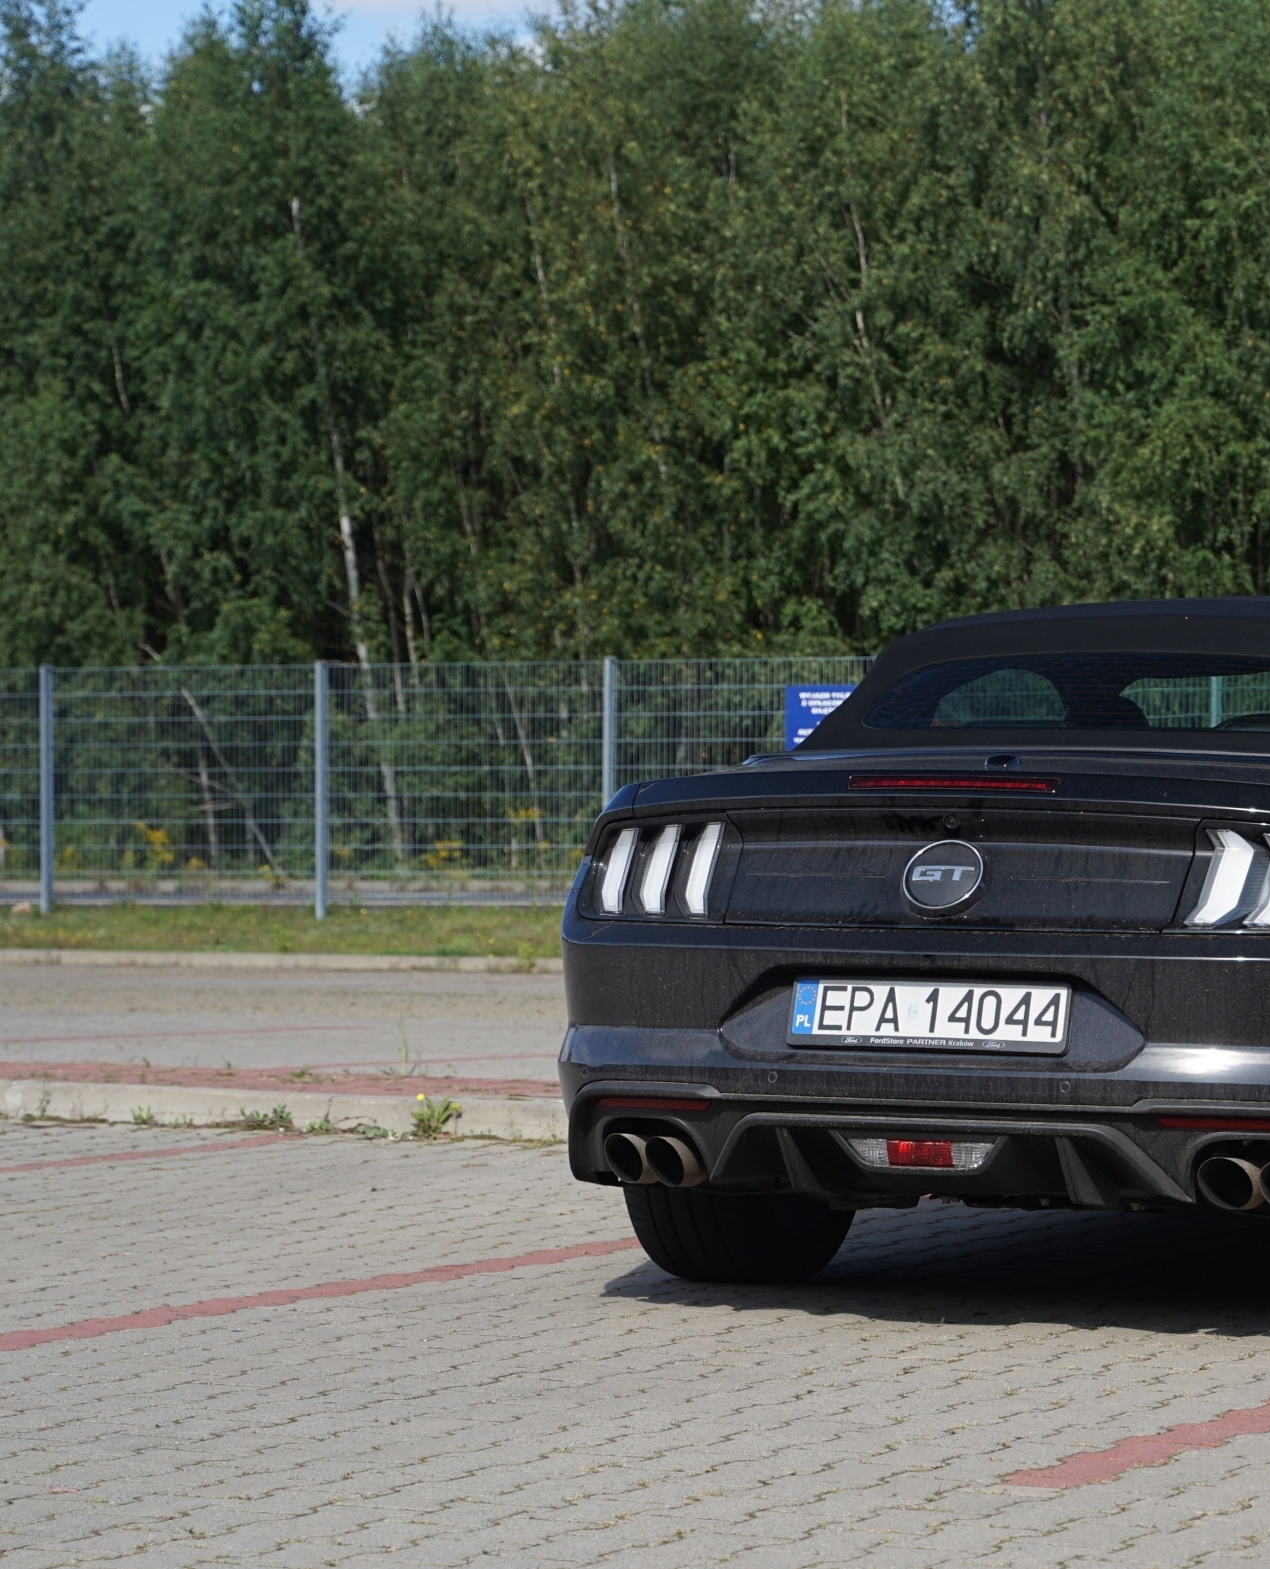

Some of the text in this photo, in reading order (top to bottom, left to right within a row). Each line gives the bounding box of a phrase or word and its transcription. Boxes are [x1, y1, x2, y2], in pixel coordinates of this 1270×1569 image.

[912, 865, 975, 881] GT
[817, 985, 1062, 1038] EPA 14044
[795, 1014, 811, 1027] PL
[869, 1037, 904, 1045] FordStore
[906, 1038, 946, 1046] PARTNER
[948, 1039, 974, 1047] Kraków
